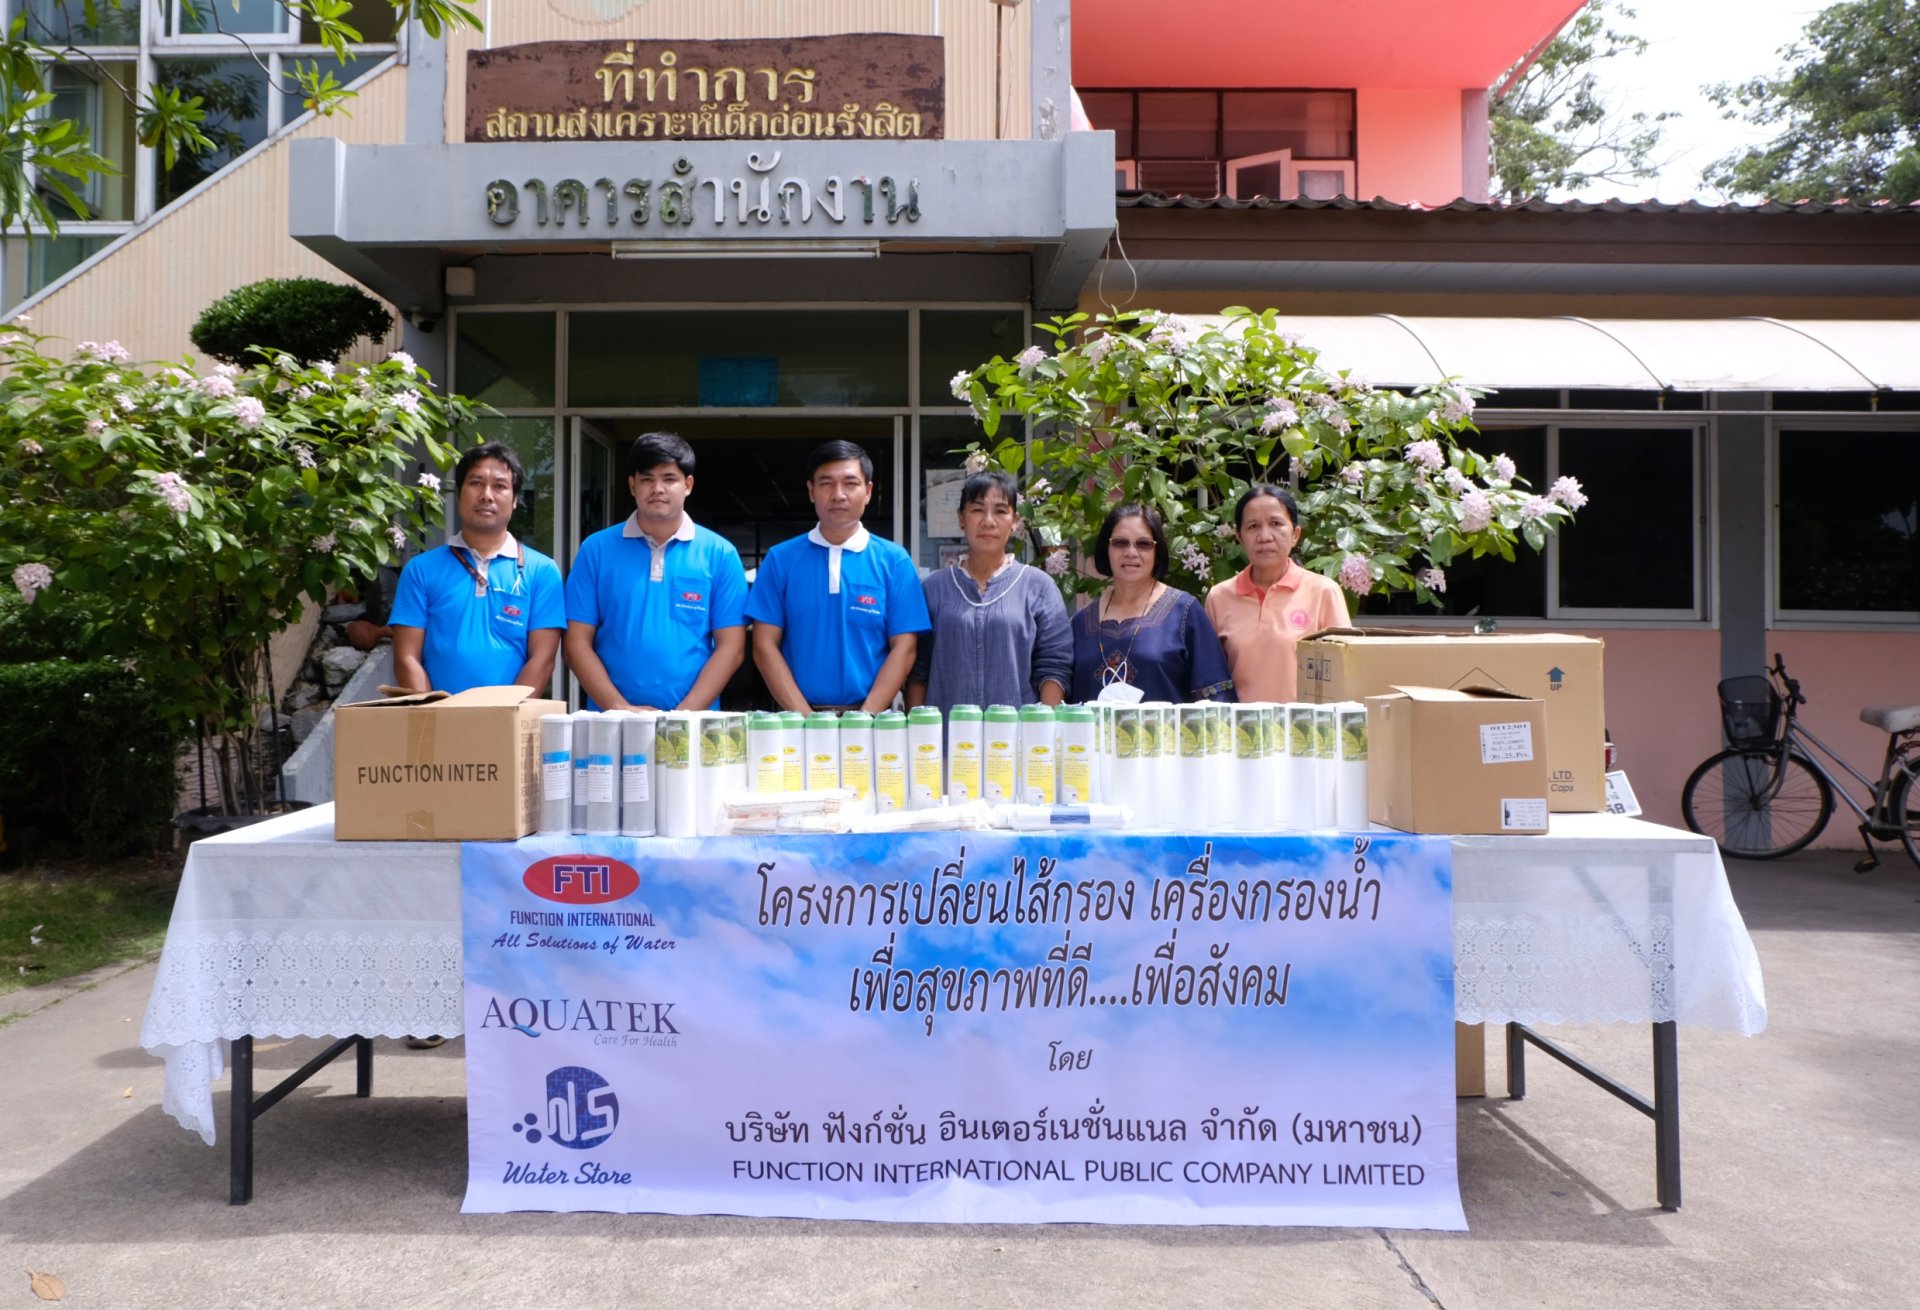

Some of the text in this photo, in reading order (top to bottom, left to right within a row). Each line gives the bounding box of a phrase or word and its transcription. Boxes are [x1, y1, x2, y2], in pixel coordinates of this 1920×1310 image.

[594, 41, 817, 103] ที่ทำการ
[485, 101, 922, 138] สถานสงเคราะห์เด็กอ่อนรังสิต
[485, 149, 923, 226] อาคารสำนักงาน
[1550, 683, 1562, 691] UP
[358, 763, 498, 785] FUNCTION INTER
[1553, 770, 1575, 780] LTD.
[1551, 784, 1574, 793] Caps
[553, 865, 610, 894] FTI
[756, 836, 1381, 927] โครงการเปลี่ยนไส้กรอง เครื่องกรองน้ำ
[510, 910, 656, 928] FUNCTION INTERNATIONAL
[491, 932, 676, 954] All Solutions of Water
[480, 996, 681, 1038] AQUATEK
[594, 1034, 678, 1048] Care For Health
[1048, 1041, 1093, 1071] โดย
[725, 1098, 1422, 1146] บริษัท ฟังก์ชั่น อินเตอร์เนชั่นแนล จำกัด (มหาชน)
[502, 1160, 632, 1185] Water Store
[733, 1158, 1425, 1186] FUNCTION INTERNATIONAL PUBLIC COMPANY LIMITED
